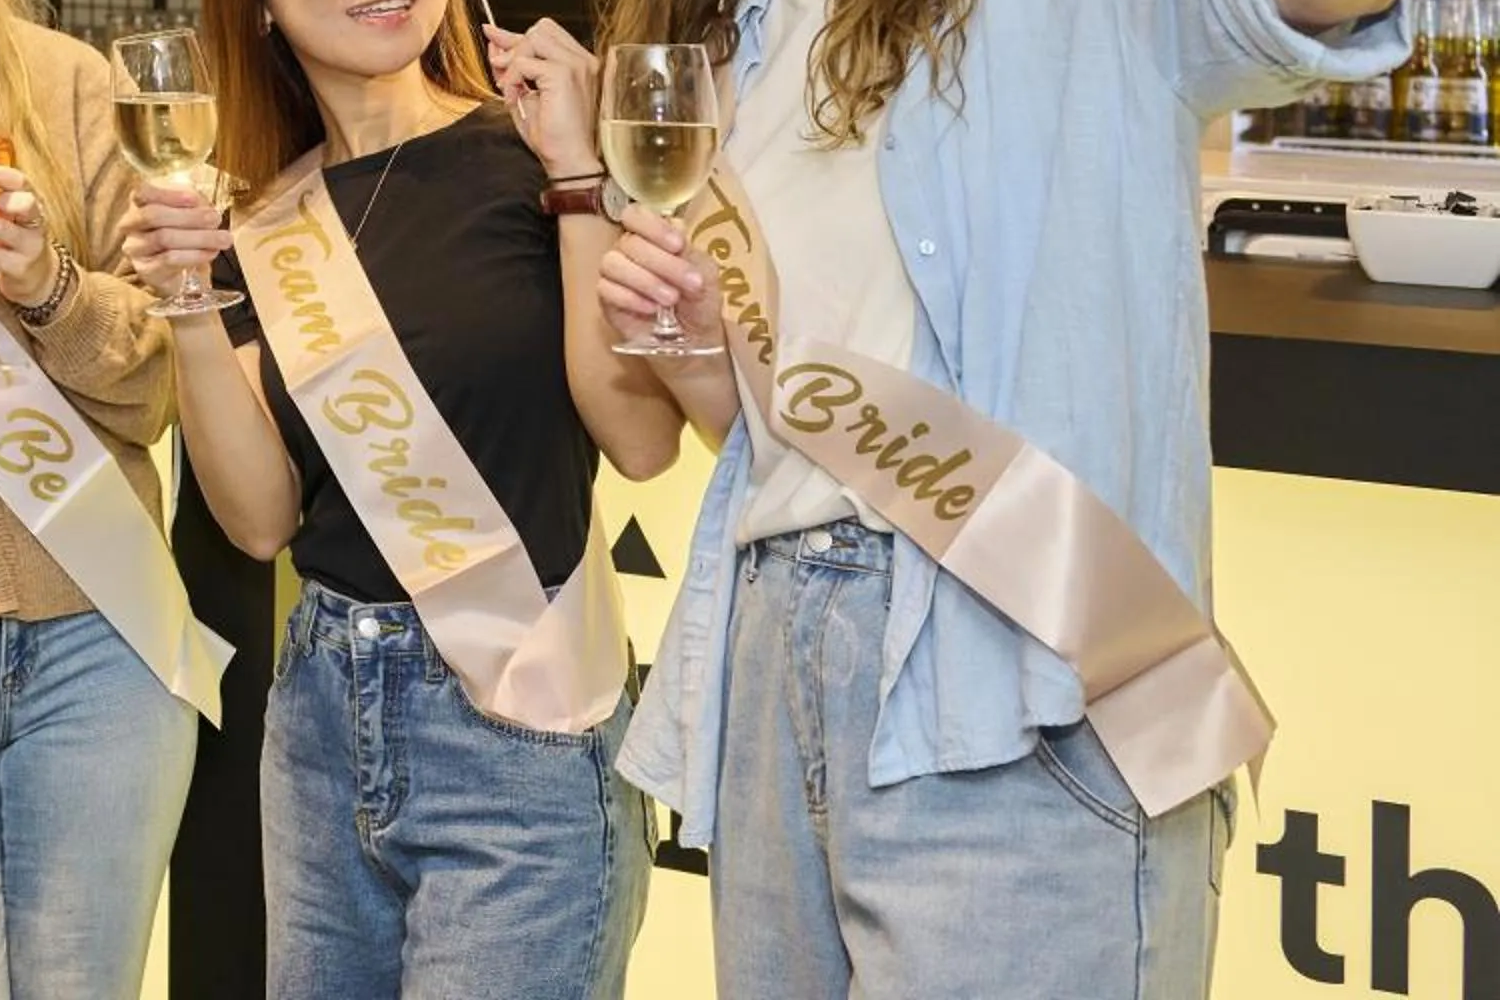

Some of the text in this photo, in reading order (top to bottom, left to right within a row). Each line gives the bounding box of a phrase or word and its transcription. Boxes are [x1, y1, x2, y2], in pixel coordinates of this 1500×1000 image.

[254, 189, 475, 572] Team Bride
[690, 168, 976, 521] Team Bride
[1256, 800, 1500, 1000] th
